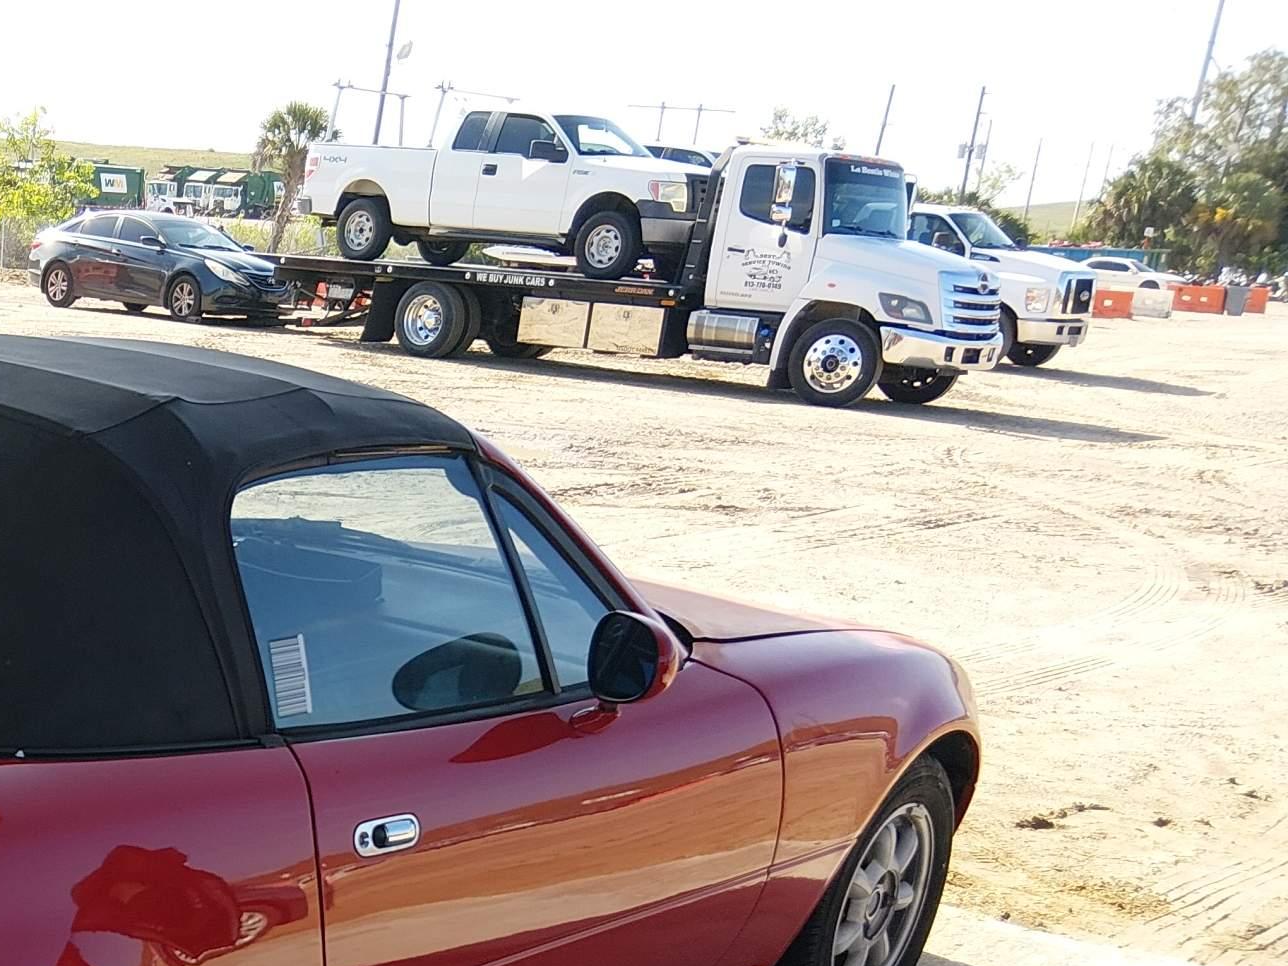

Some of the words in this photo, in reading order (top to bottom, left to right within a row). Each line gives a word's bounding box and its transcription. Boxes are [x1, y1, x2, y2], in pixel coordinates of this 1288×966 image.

[476, 272, 487, 282] WE
[488, 273, 504, 283] BUY
[504, 274, 524, 285] JUNK
[525, 276, 546, 287] CARS
